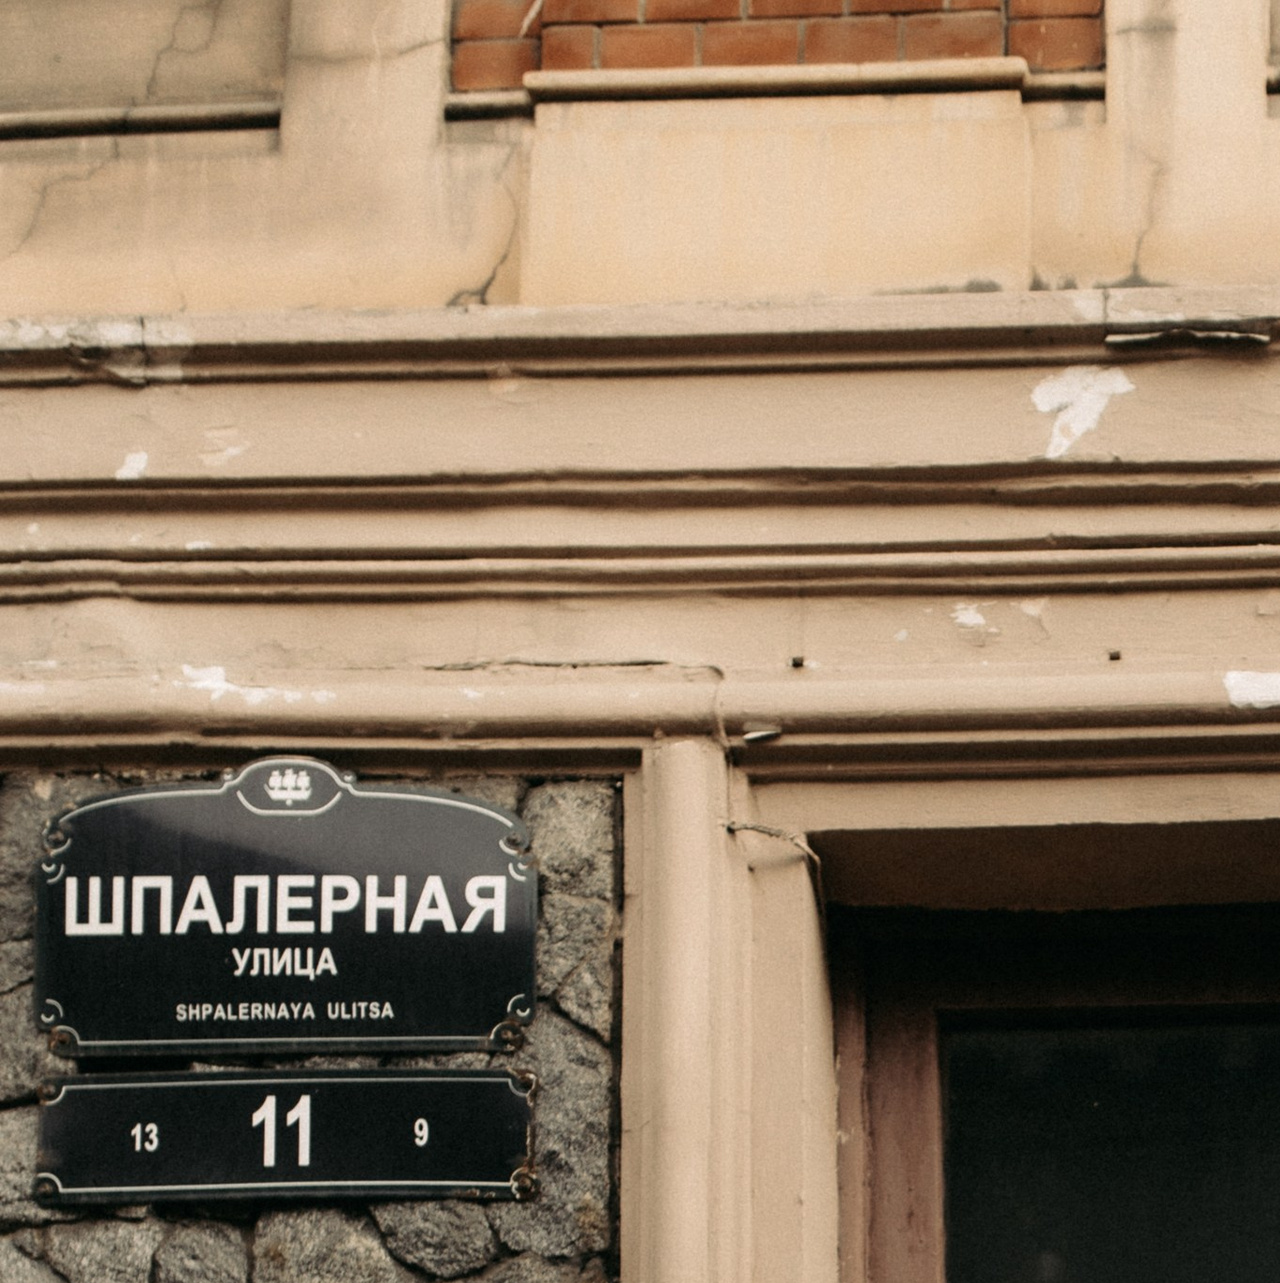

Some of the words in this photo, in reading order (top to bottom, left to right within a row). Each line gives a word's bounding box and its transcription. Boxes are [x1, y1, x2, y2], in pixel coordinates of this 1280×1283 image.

[64, 874, 507, 936] ШПАЛЕРНАЯ
[232, 947, 338, 980] УЛИЦА
[175, 1002, 316, 1021] SHPALERNAYA
[327, 1001, 395, 1020] ULITSA
[130, 1122, 160, 1152] 13
[251, 1094, 312, 1167] 11
[413, 1118, 430, 1147] 9
